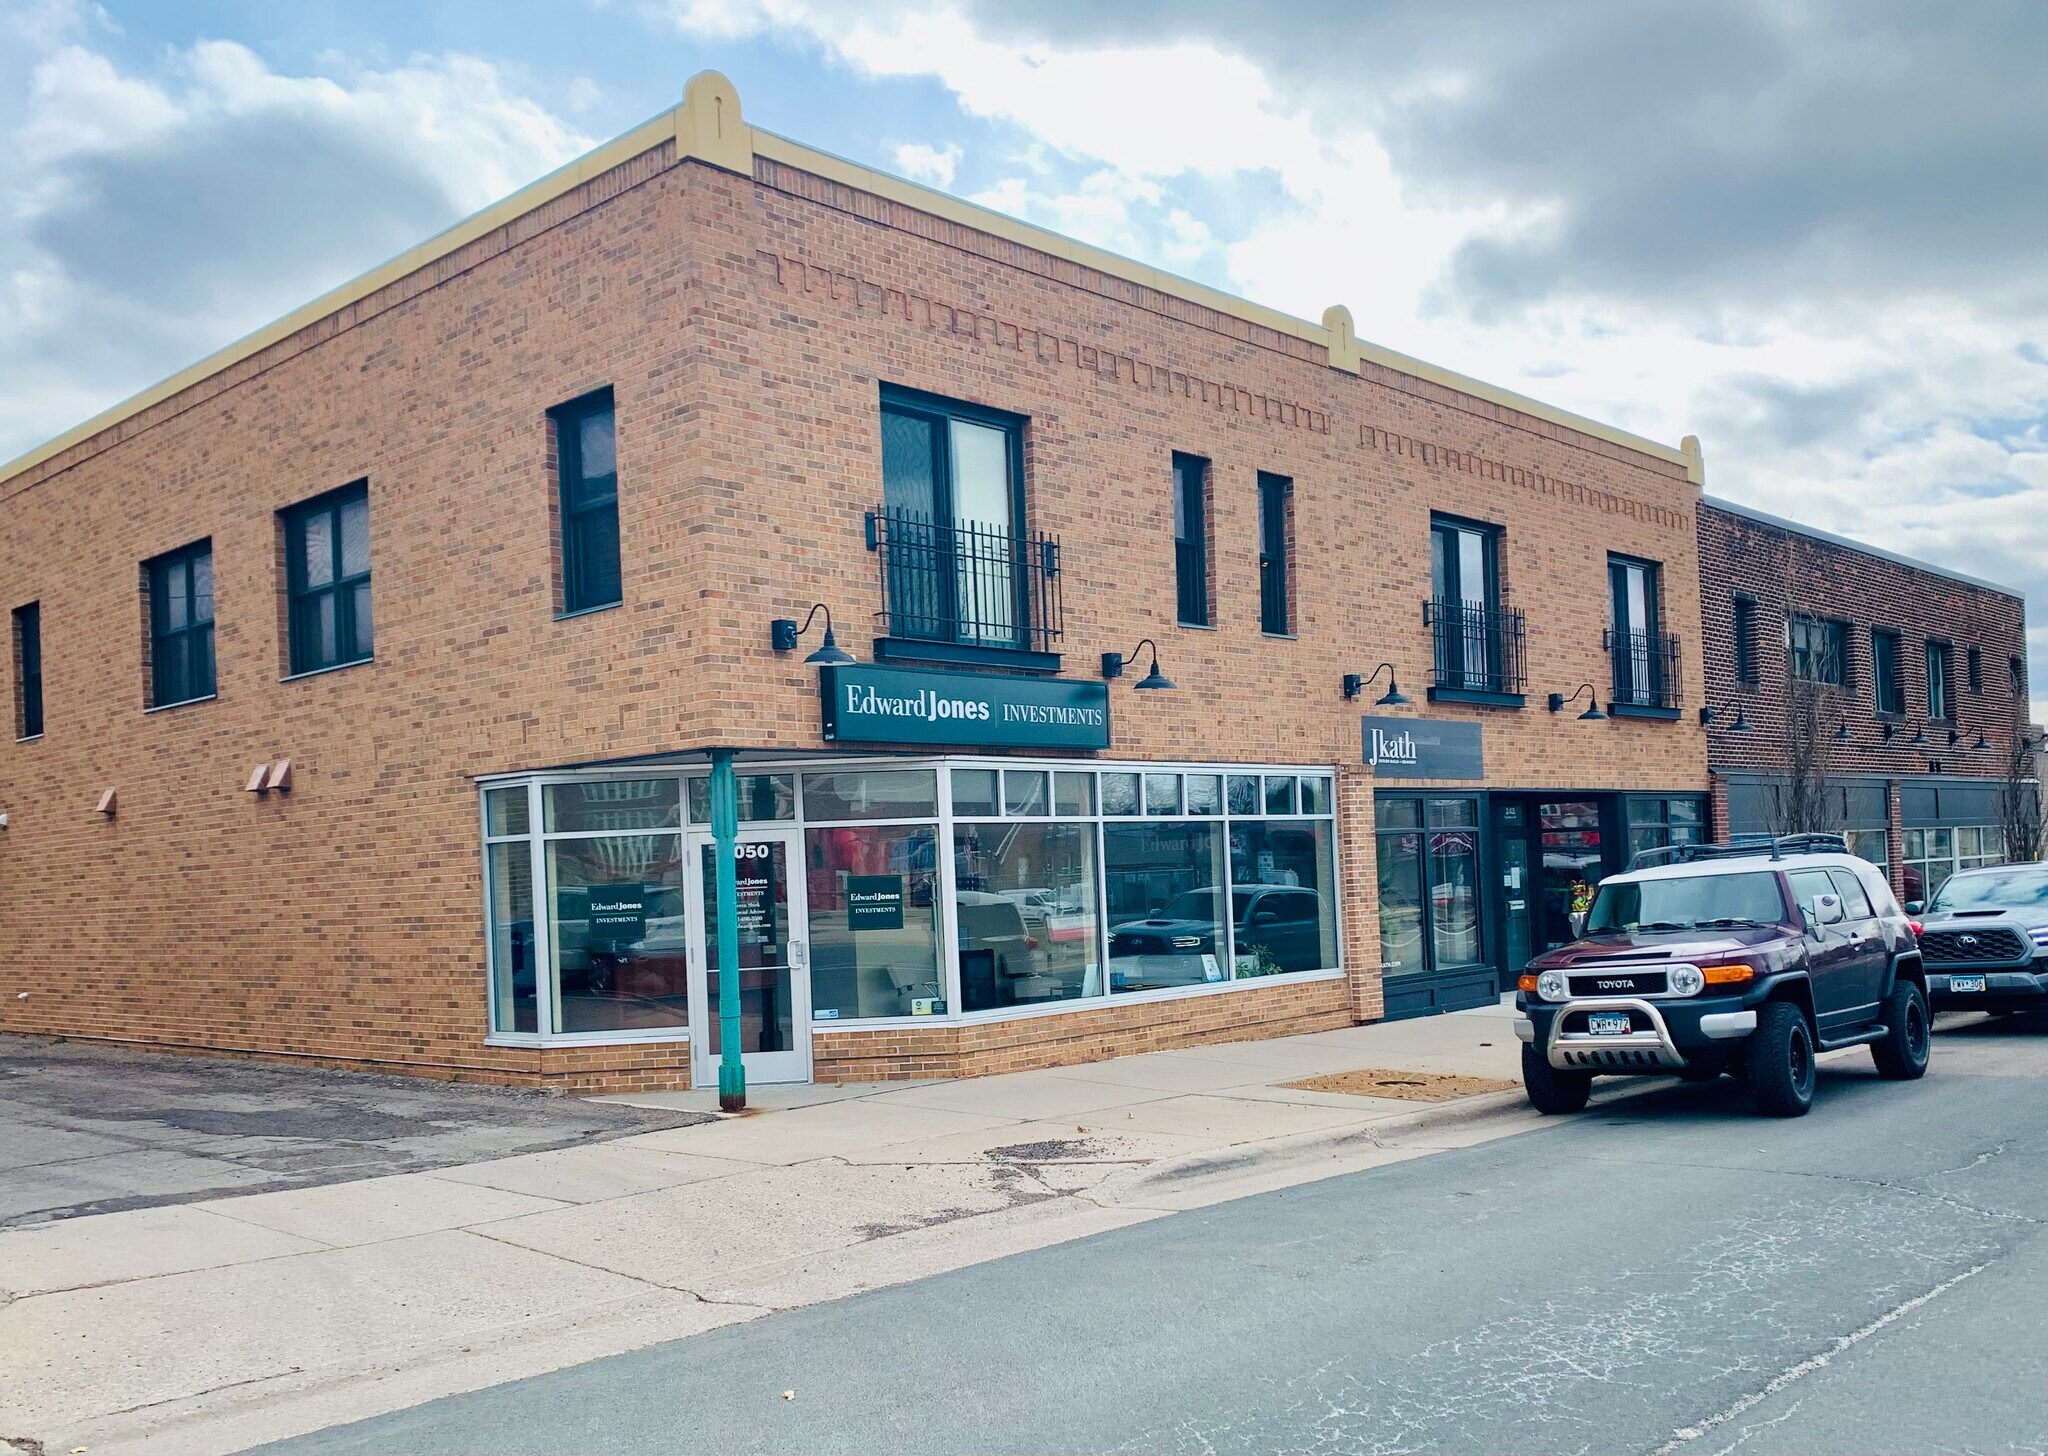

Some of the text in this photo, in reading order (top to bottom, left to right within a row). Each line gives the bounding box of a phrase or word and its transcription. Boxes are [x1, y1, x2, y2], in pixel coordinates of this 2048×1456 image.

[1003, 703, 1103, 726] INVESTMENTS
[1369, 728, 1417, 766] Jkath
[734, 844, 769, 859] 050
[736, 877, 768, 886] ardJones
[855, 906, 896, 914] INVESTMENTS
[596, 916, 638, 924] INVESTMENTS
[1597, 979, 1635, 989] TOYOTA
